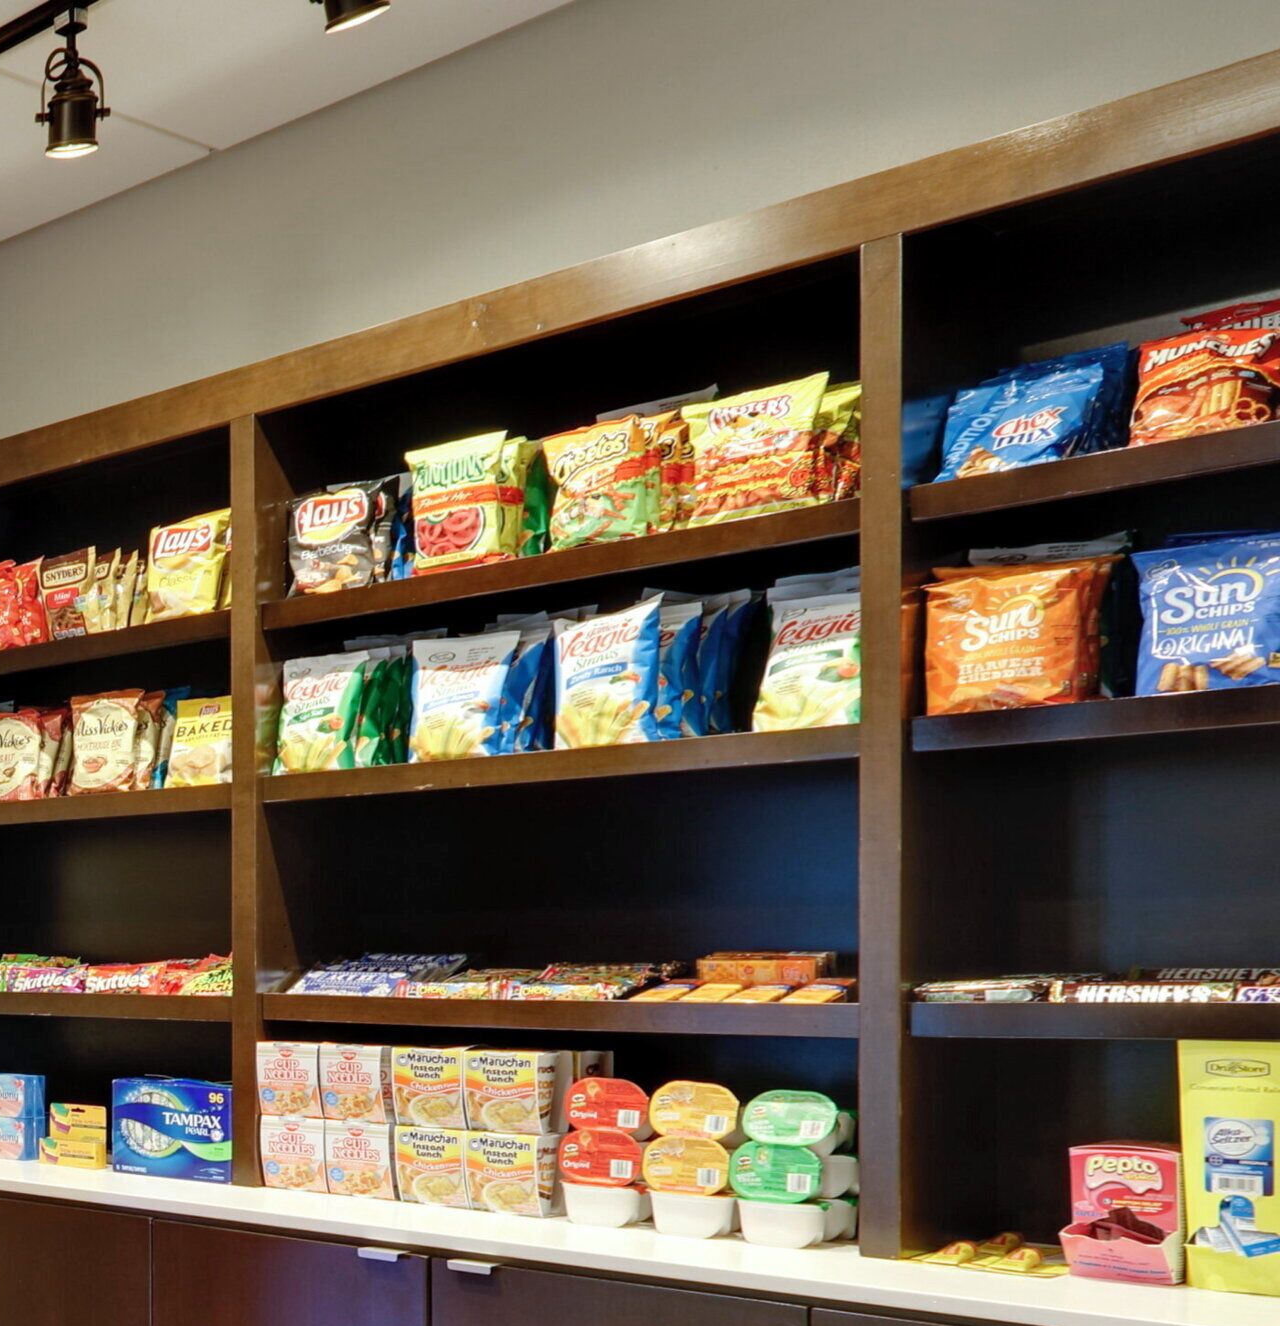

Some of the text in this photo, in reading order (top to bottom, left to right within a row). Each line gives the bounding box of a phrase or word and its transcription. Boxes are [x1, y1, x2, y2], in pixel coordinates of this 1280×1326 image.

[1144, 333, 1276, 373] MUNCHIES
[553, 432, 630, 480] Cheetos
[45, 565, 85, 583] SNYDER'S
[1160, 576, 1259, 625] Sun
[1194, 601, 1256, 619] CHIPS
[960, 603, 1044, 652] Sun
[989, 626, 1041, 645] CHIPS
[561, 624, 640, 662] Veggie
[176, 718, 232, 738] BAKED
[13, 973, 72, 993] Skittles
[86, 973, 150, 993] Skittles
[1078, 985, 1211, 1003] HERSHEY'S
[274, 1059, 299, 1070] CUP
[407, 1053, 457, 1065] Maruchan
[479, 1057, 532, 1068] Maruchan
[337, 1062, 362, 1073] CUP
[410, 1064, 444, 1073] Instant
[482, 1067, 519, 1077] Instant
[414, 1071, 441, 1080] Lunch
[486, 1075, 515, 1083] Lunch
[209, 1092, 224, 1104] 96
[162, 1111, 221, 1129] TAMPAX
[279, 1132, 305, 1143] CUP
[343, 1137, 370, 1149] CUP
[409, 1132, 458, 1144] Maruchan
[412, 1142, 446, 1152] Instant
[479, 1138, 530, 1151] Maruchan
[416, 1150, 442, 1158] Lunch
[482, 1149, 518, 1158] Instant
[486, 1157, 515, 1166] Lunch
